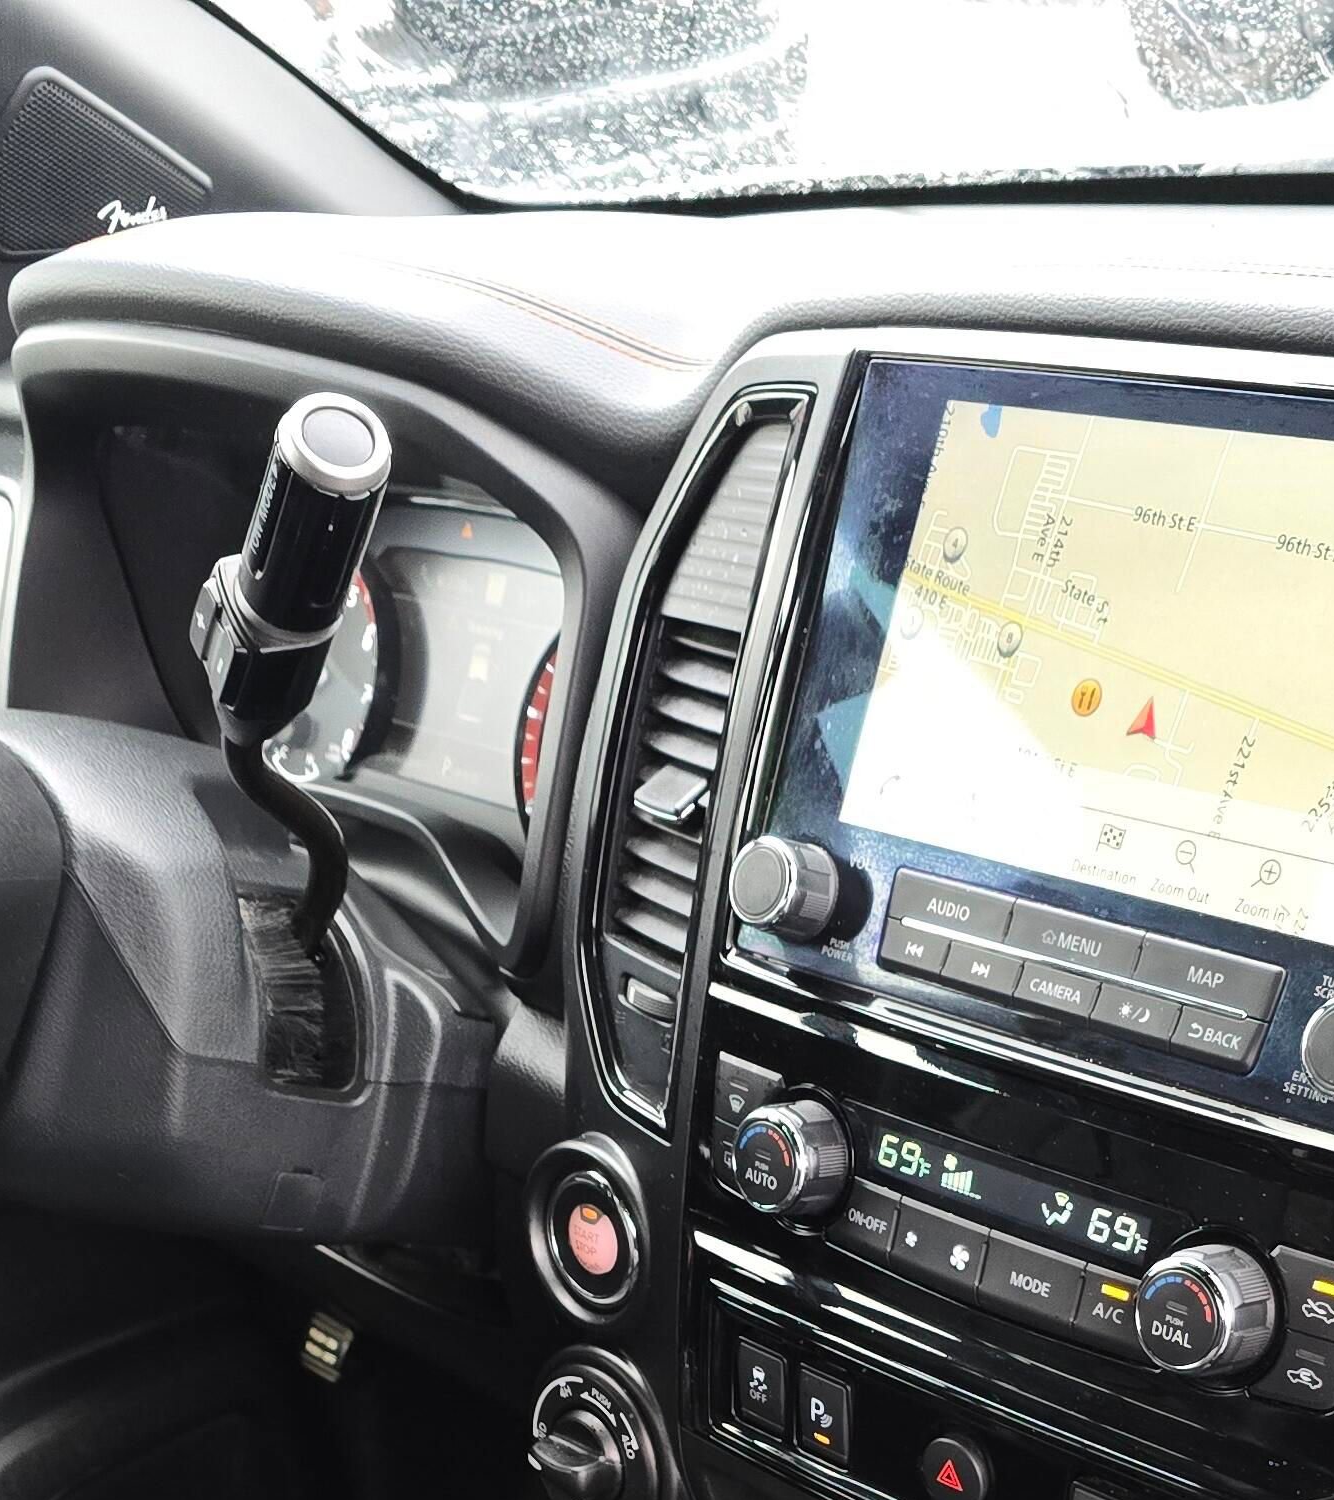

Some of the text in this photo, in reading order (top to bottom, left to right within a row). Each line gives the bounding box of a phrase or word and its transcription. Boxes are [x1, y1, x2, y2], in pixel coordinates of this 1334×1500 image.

[1133, 506, 1198, 532] 96th St E
[1032, 513, 1055, 563] Ave E
[1046, 516, 1073, 568] 214th
[1275, 535, 1312, 555] 96th
[1315, 542, 1332, 560] St
[934, 571, 970, 596] Route
[914, 584, 948, 609] 410 E
[1061, 579, 1109, 624] State St
[1226, 735, 1256, 787] 221st
[1072, 858, 1136, 885] Destination
[1150, 877, 1210, 905] Zoom Out
[927, 897, 970, 921] AUDIO
[1235, 898, 1269, 919] Zoom
[1273, 907, 1285, 922] In
[821, 945, 854, 963] POWER
[1057, 933, 1102, 957] MENU
[1187, 965, 1224, 989] MAP
[1029, 977, 1081, 1005] CAMERA
[1203, 1027, 1243, 1051] BACK
[745, 1167, 777, 1190] AUTO
[1010, 1271, 1052, 1298] MODE
[1092, 1302, 1124, 1325] A/C
[1151, 1320, 1192, 1349] DUAL
[749, 1388, 768, 1404] OFF
